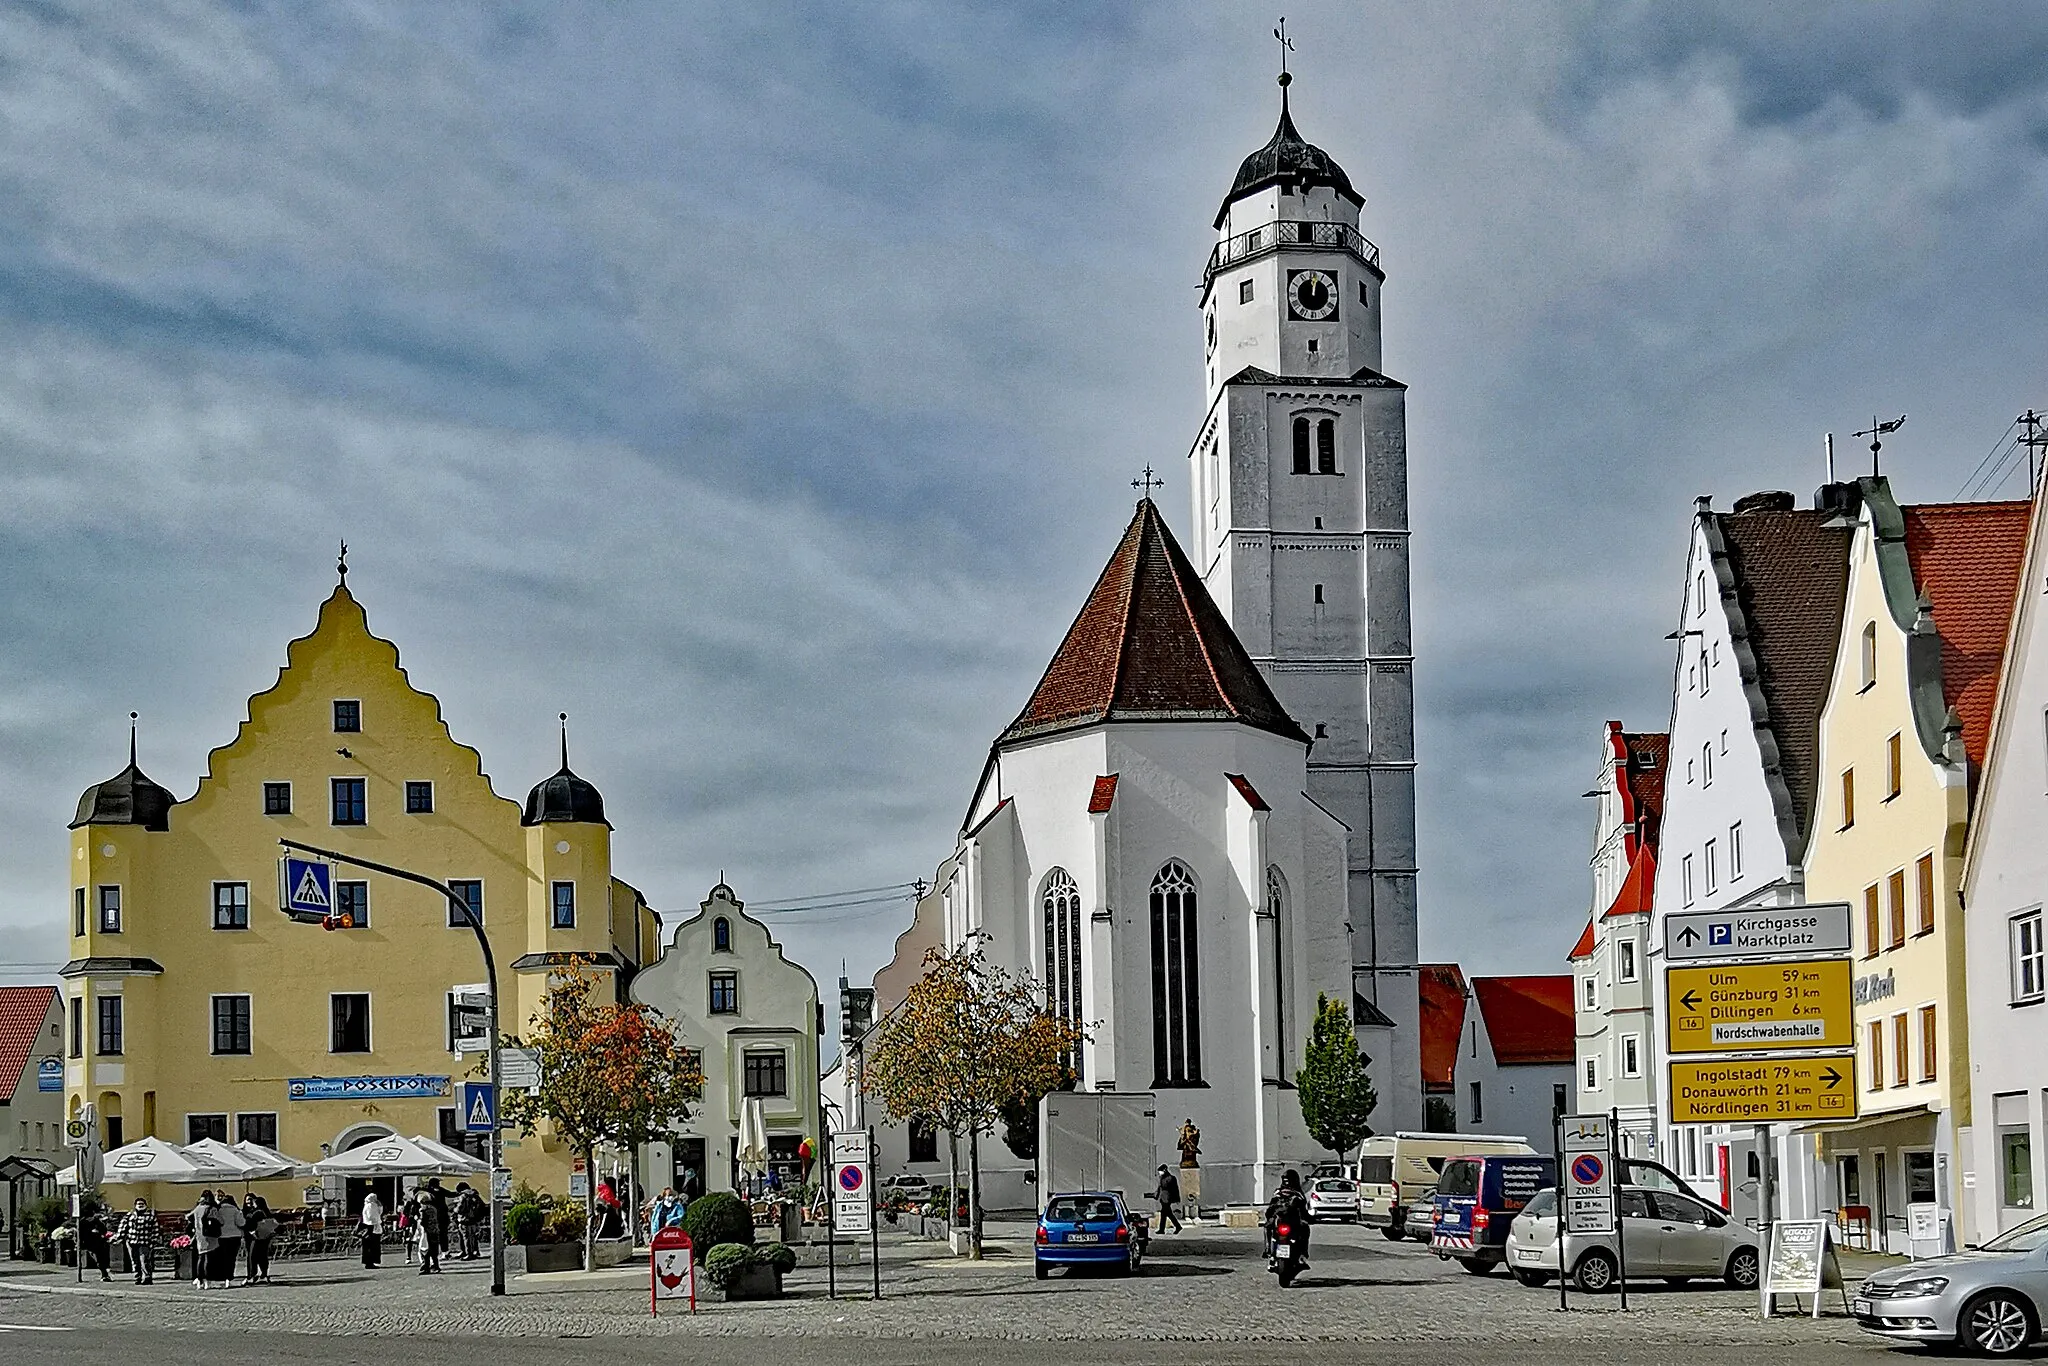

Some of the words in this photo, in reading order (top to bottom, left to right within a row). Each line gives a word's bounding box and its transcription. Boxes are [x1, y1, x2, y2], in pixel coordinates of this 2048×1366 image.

[1737, 917, 1818, 931] Kirchgasse
[1713, 926, 1727, 943] P
[1737, 933, 1814, 948] Marktplatz
[1709, 973, 1738, 985] Ulm
[1782, 970, 1799, 982] 59
[1803, 972, 1820, 981] km
[1710, 988, 1778, 1003] Günzburg
[1784, 987, 1799, 999] 31
[1803, 988, 1820, 997] km
[1711, 1005, 1774, 1020] Dillingen
[1792, 1003, 1800, 1015] 6
[1803, 1005, 1821, 1015] km
[1685, 1019, 1697, 1028] 16
[1716, 1024, 1820, 1040] Nordschwabenhalle
[1696, 1068, 1767, 1083] Ingolstadt
[1773, 1067, 1790, 1079] 79
[1794, 1069, 1811, 1078] km
[1682, 1084, 1768, 1099] Donauwörth
[1775, 1084, 1790, 1096] 21
[1794, 1086, 1811, 1095] km
[1690, 1101, 1769, 1116] Nördlingen
[1776, 1101, 1791, 1112] 31
[1795, 1103, 1812, 1112] km
[1825, 1097, 1838, 1106] 16
[842, 1192, 861, 1200] ZONE
[1576, 1187, 1601, 1195] ZONE
